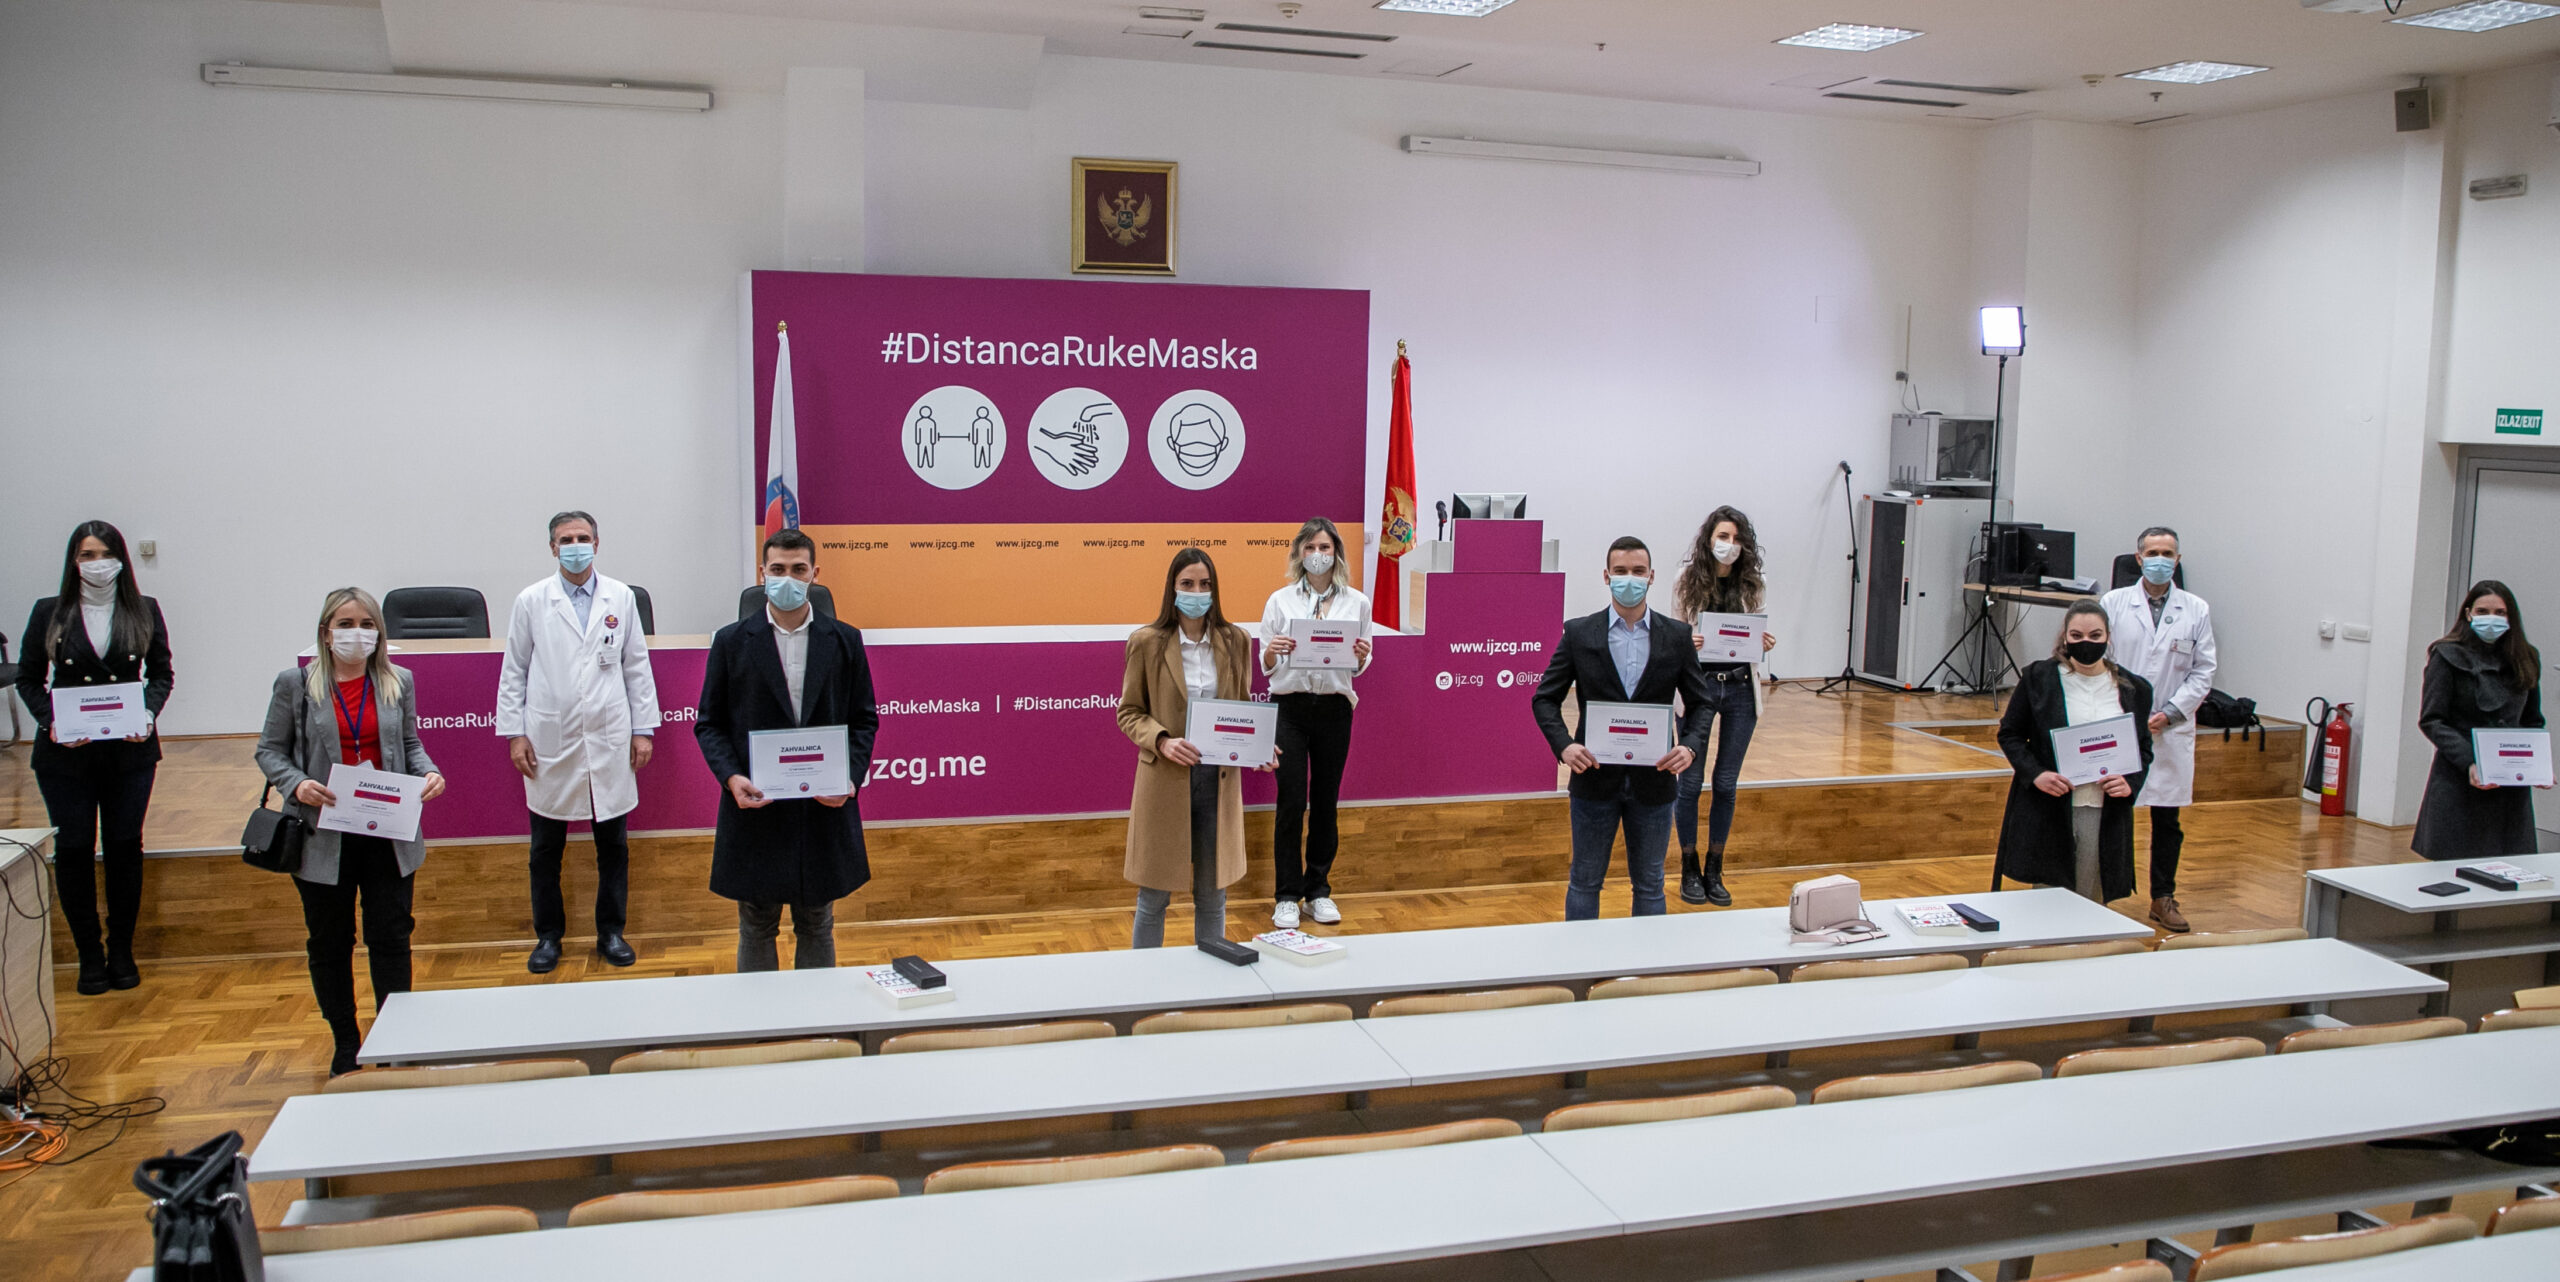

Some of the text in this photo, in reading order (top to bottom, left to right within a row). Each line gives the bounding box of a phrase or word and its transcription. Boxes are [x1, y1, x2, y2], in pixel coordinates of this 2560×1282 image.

[881, 332, 1257, 370] #DistancaRukeMaska
[2496, 414, 2541, 429] IZLAZ/EXIT
[822, 537, 1292, 550] www.ijzcg.me www.ijzcg.me www.ijzcg.me www.ijzcg.me www.ijzcg.me www.ijzcg.
[1450, 639, 1542, 656] www.ijzcg.me
[1455, 671, 1484, 687] ijz.cg
[80, 695, 120, 703] ZAHVALNICA
[1216, 716, 1254, 725] ZAHVALNICA
[2080, 733, 2115, 744] ZAHVALNICA
[780, 745, 821, 753] ZAHVALNICA
[358, 781, 401, 793] ZAHVALNICA
